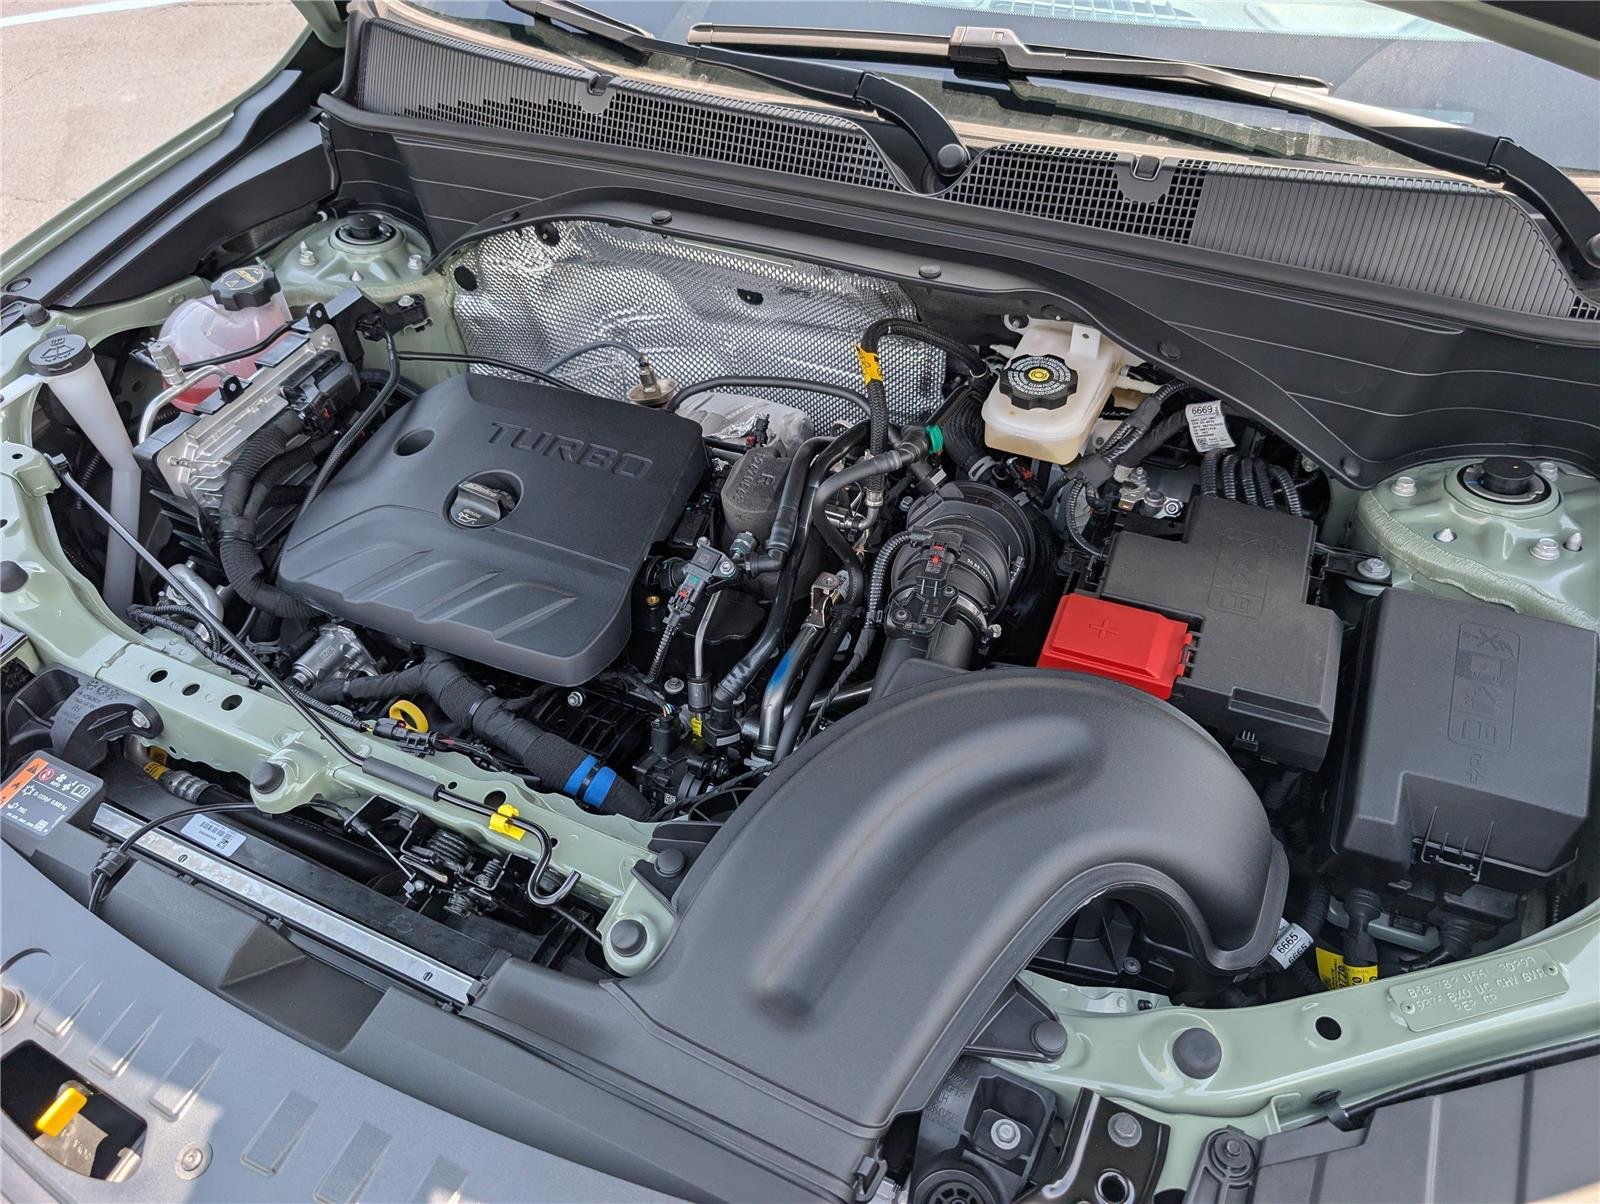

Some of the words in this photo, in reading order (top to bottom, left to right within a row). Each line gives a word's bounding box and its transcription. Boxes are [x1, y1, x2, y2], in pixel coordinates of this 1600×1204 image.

[1191, 405, 1213, 415] 6669
[488, 421, 653, 479] TURBO
[1276, 932, 1299, 954] 6665
